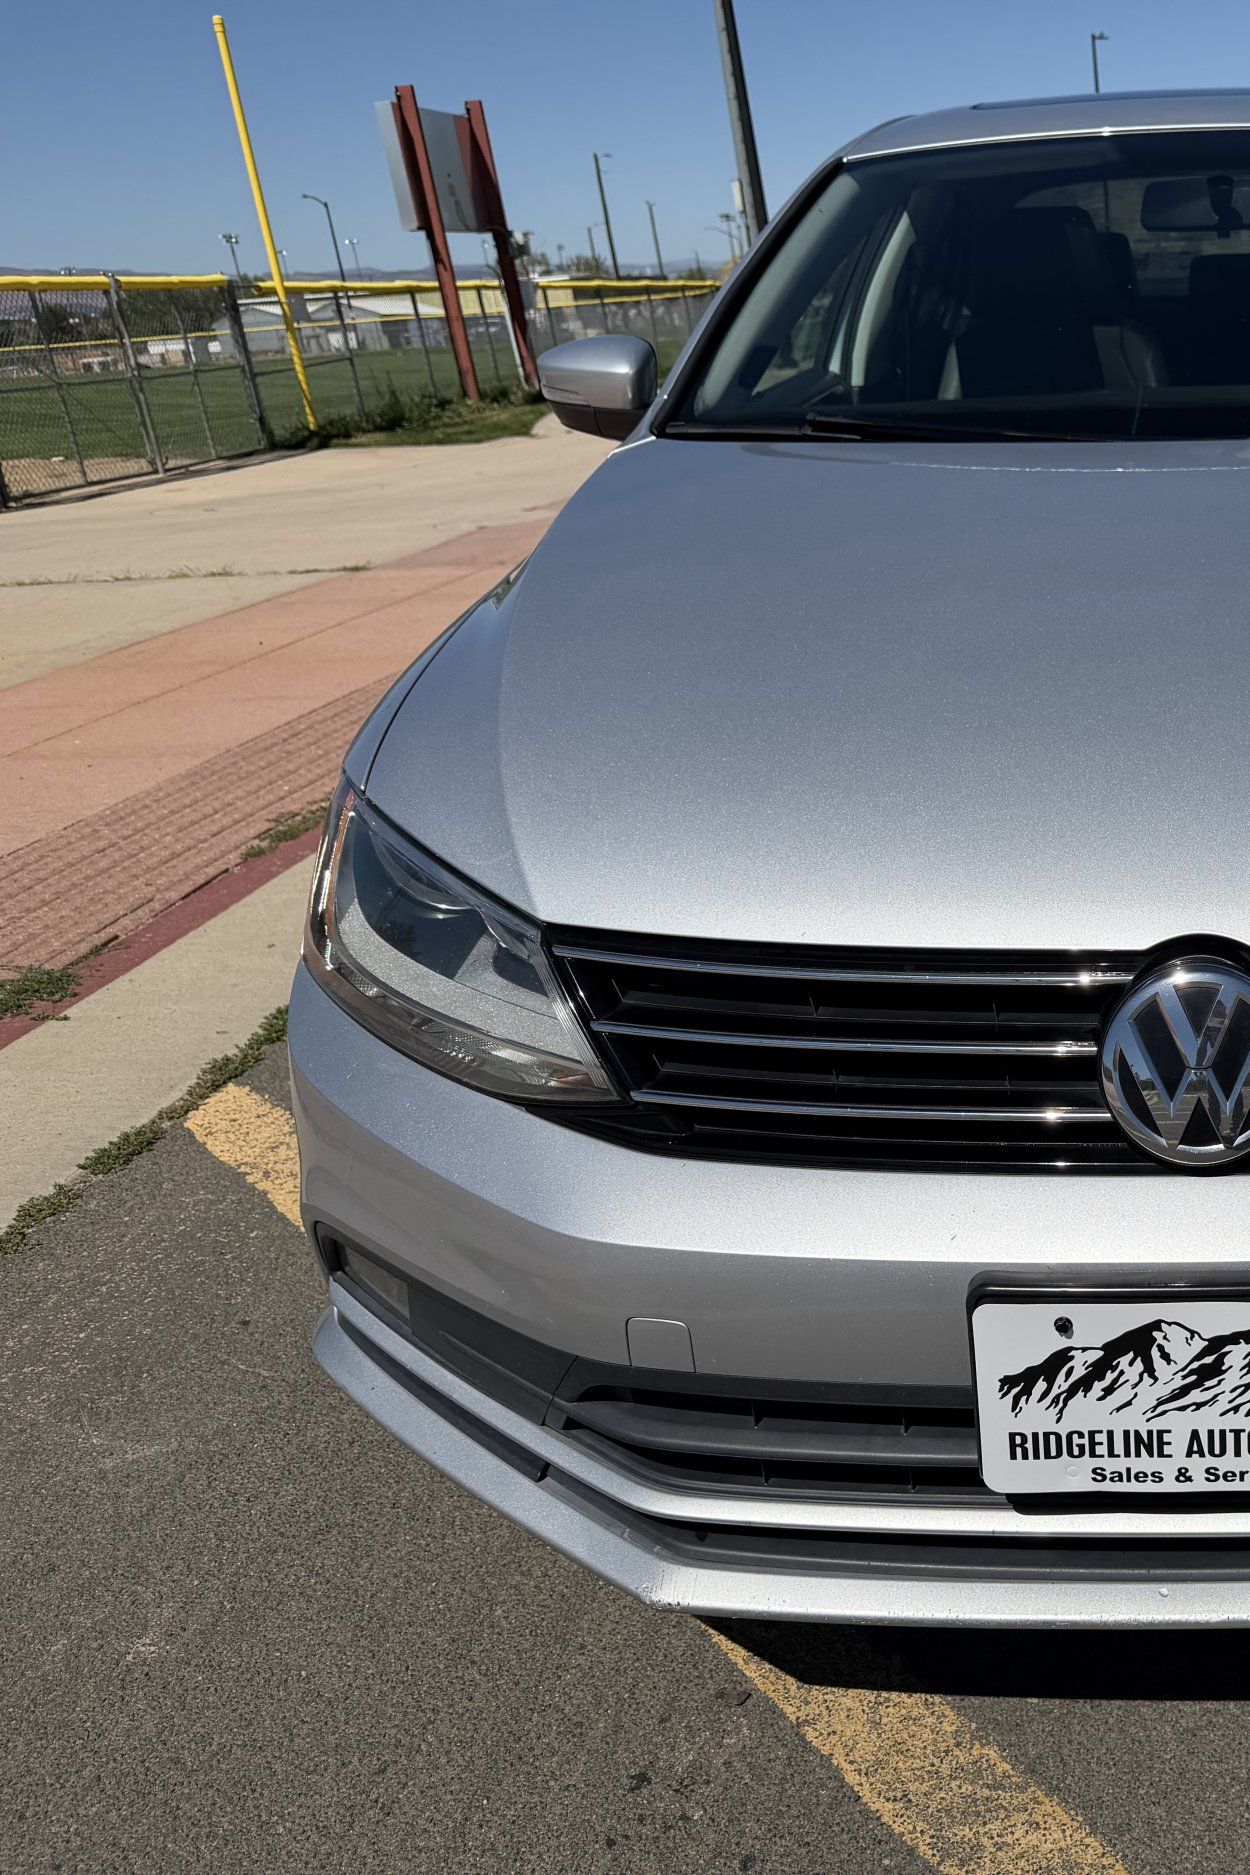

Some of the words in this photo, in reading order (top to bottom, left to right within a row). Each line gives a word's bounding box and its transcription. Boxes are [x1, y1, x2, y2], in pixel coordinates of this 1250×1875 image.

[1009, 1430, 1172, 1460] RIDGELINE
[1091, 1467, 1164, 1483] Sales
[1175, 1467, 1193, 1483] &
